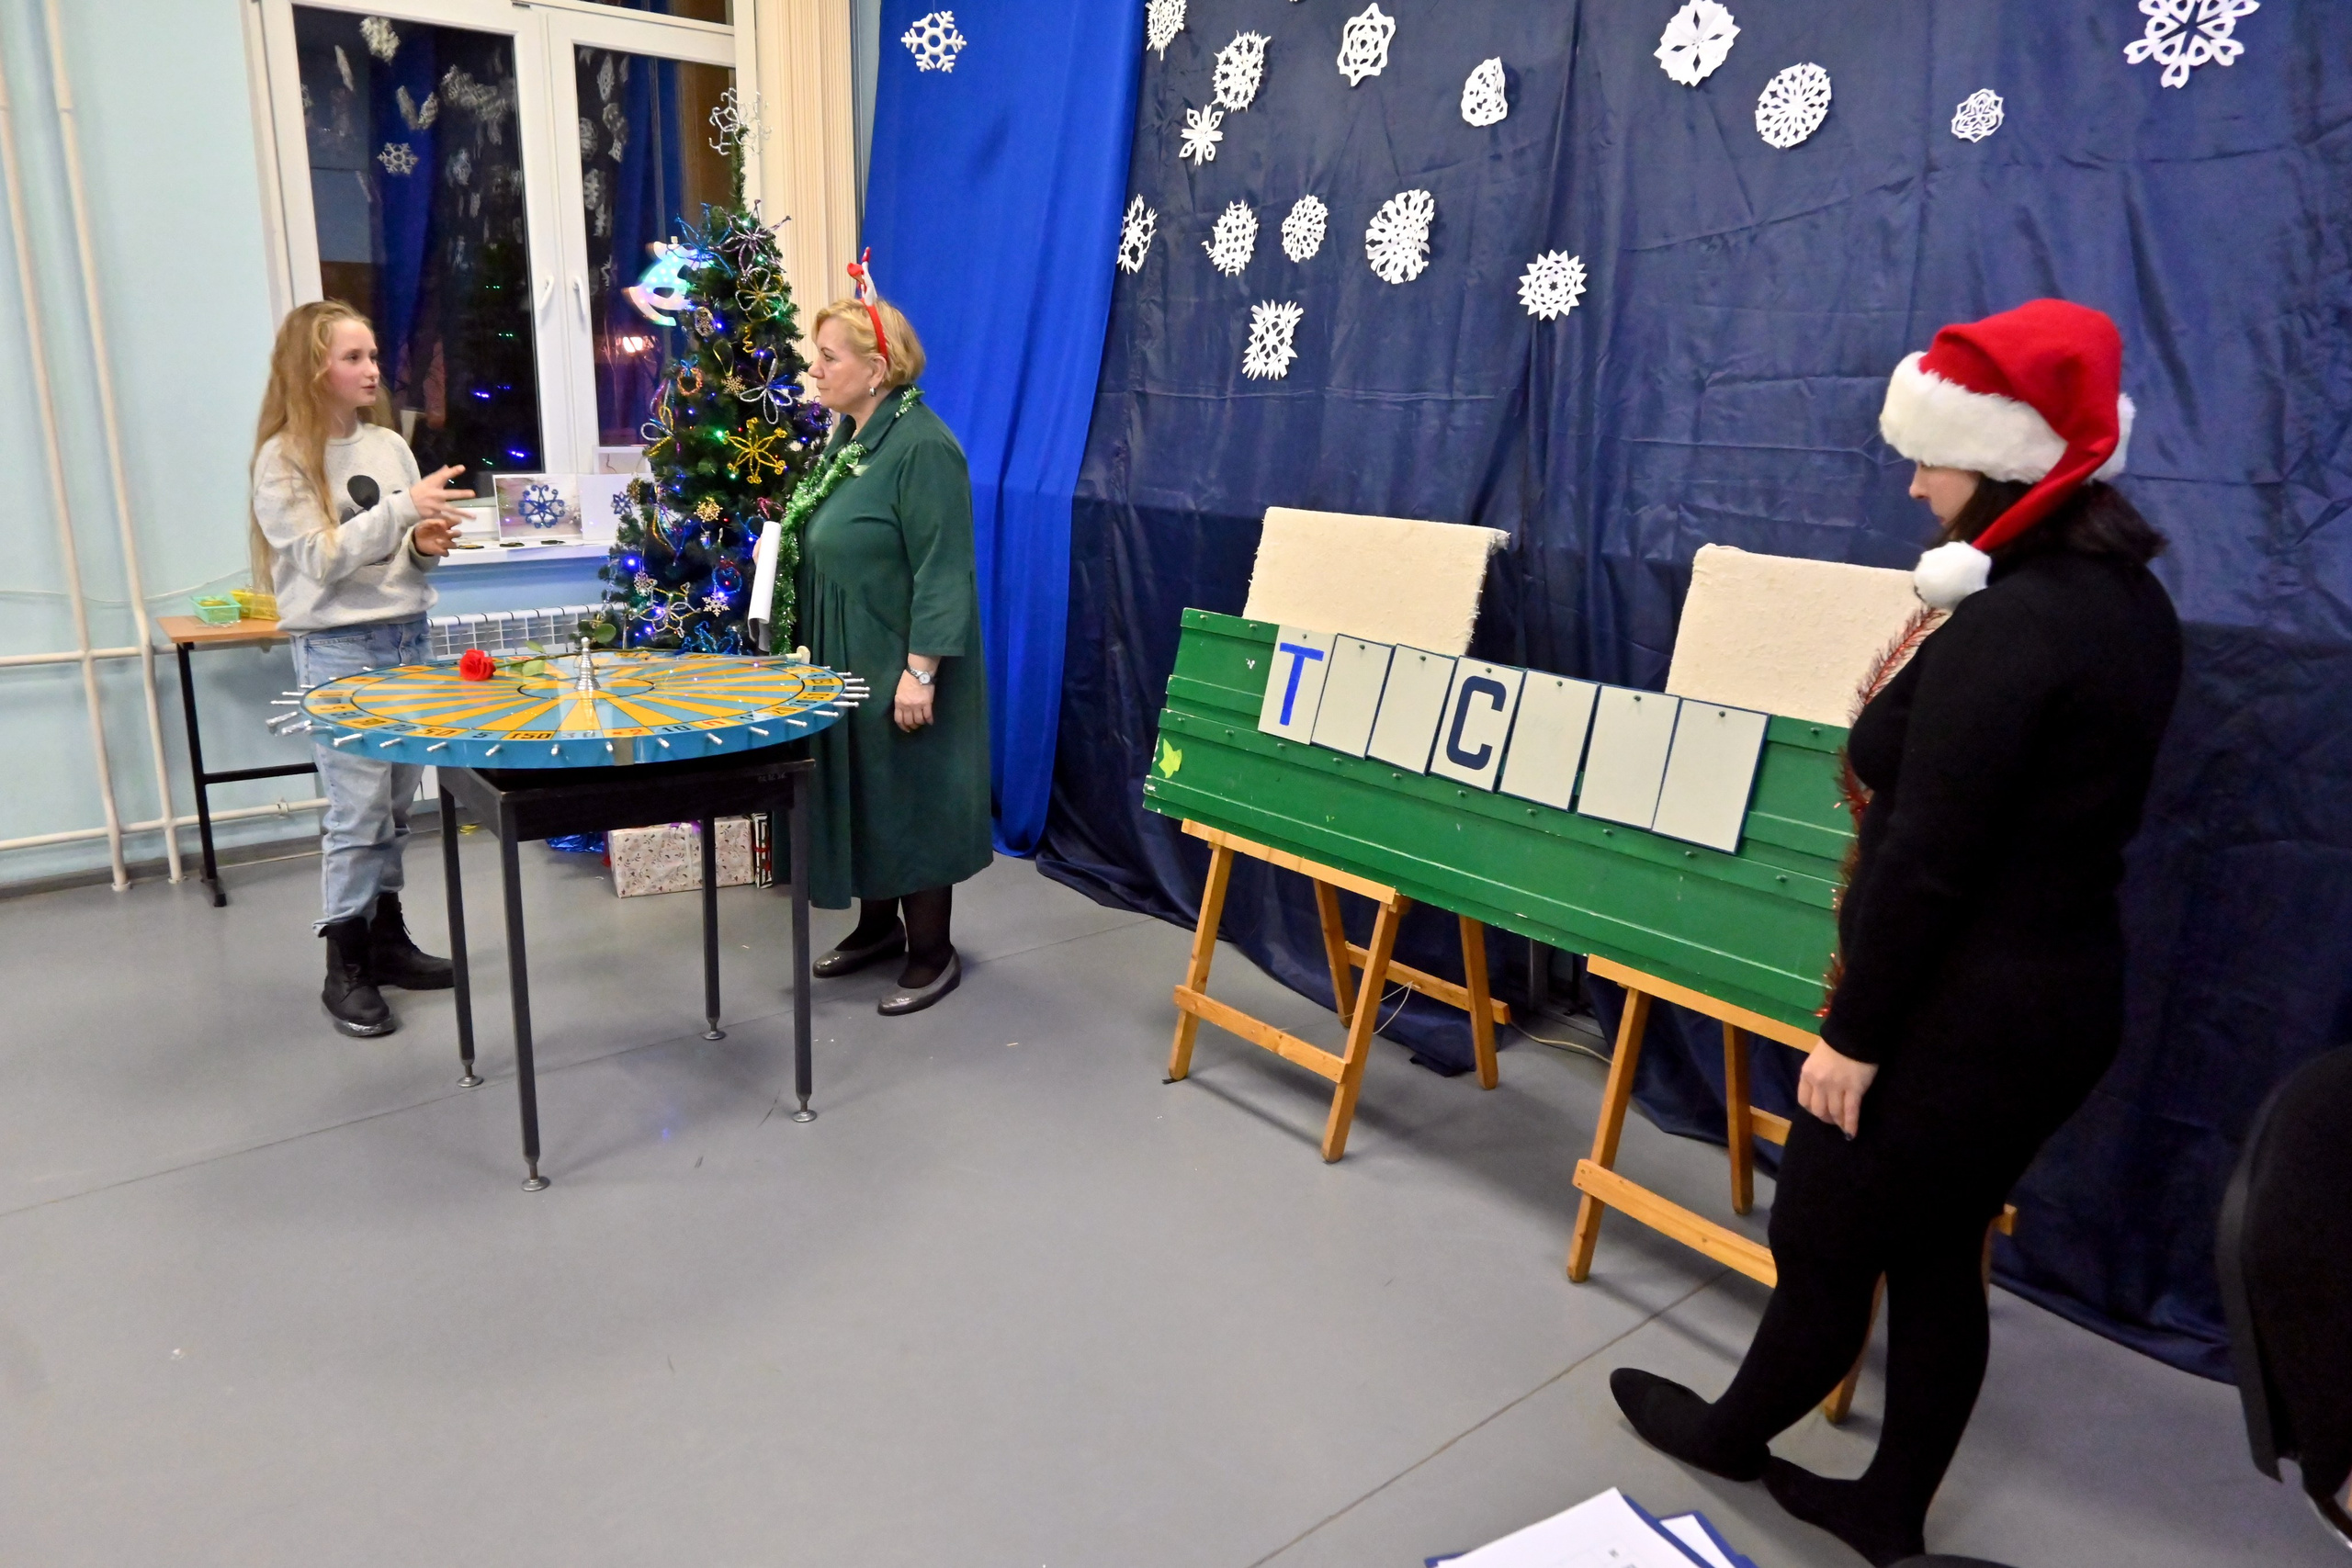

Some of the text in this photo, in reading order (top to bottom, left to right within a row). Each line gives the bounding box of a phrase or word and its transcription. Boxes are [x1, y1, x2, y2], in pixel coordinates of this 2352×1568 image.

[425, 728, 457, 736] 50
[1278, 643, 1507, 770] Т С
